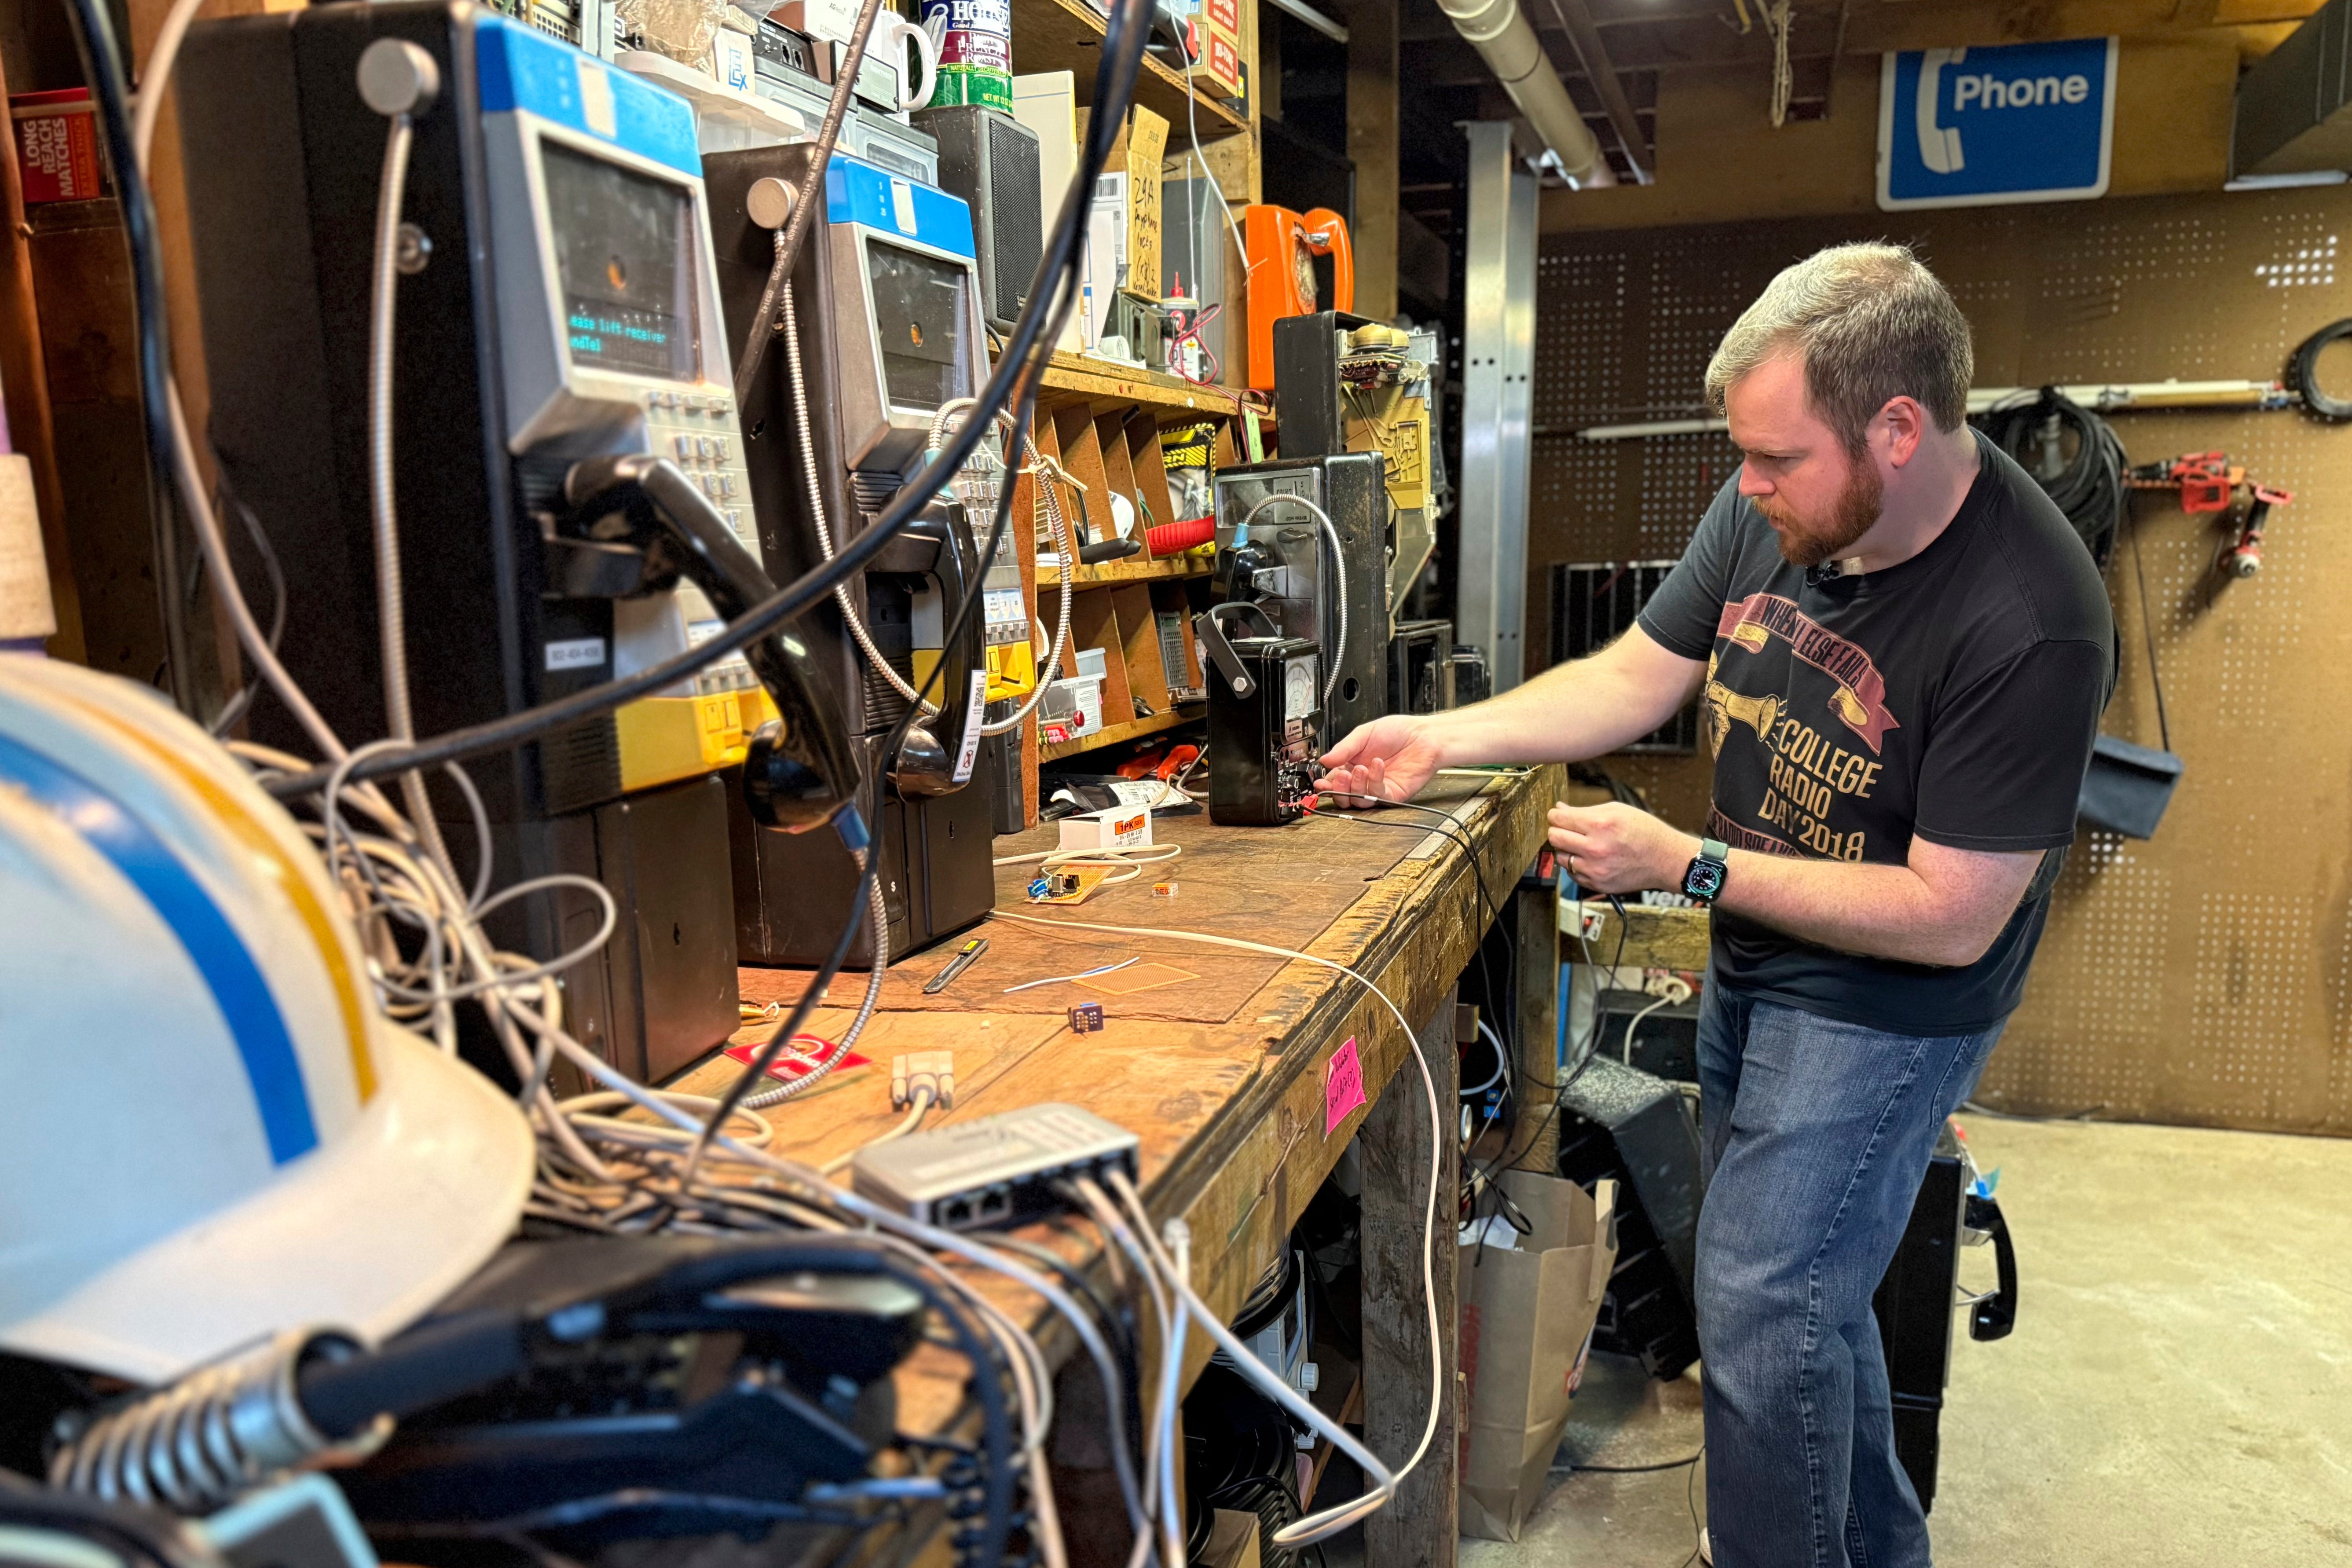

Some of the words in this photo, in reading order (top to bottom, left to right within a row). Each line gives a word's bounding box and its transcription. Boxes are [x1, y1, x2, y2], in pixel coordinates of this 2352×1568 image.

[1954, 73, 2089, 111] Phone
[23, 120, 41, 167] LONG
[38, 119, 56, 174] REACH
[52, 117, 75, 196] MATCHES
[599, 318, 621, 335] lift
[625, 327, 667, 344] receiver
[1761, 597, 1798, 639] WHEN
[1799, 628, 1840, 667] ELSE
[1769, 753, 1832, 820] RADIO
[1779, 719, 1883, 799] COLLEGE
[1120, 821, 1133, 832] 1PK
[1758, 787, 1800, 835] DAY
[1799, 815, 1865, 863] 2018
